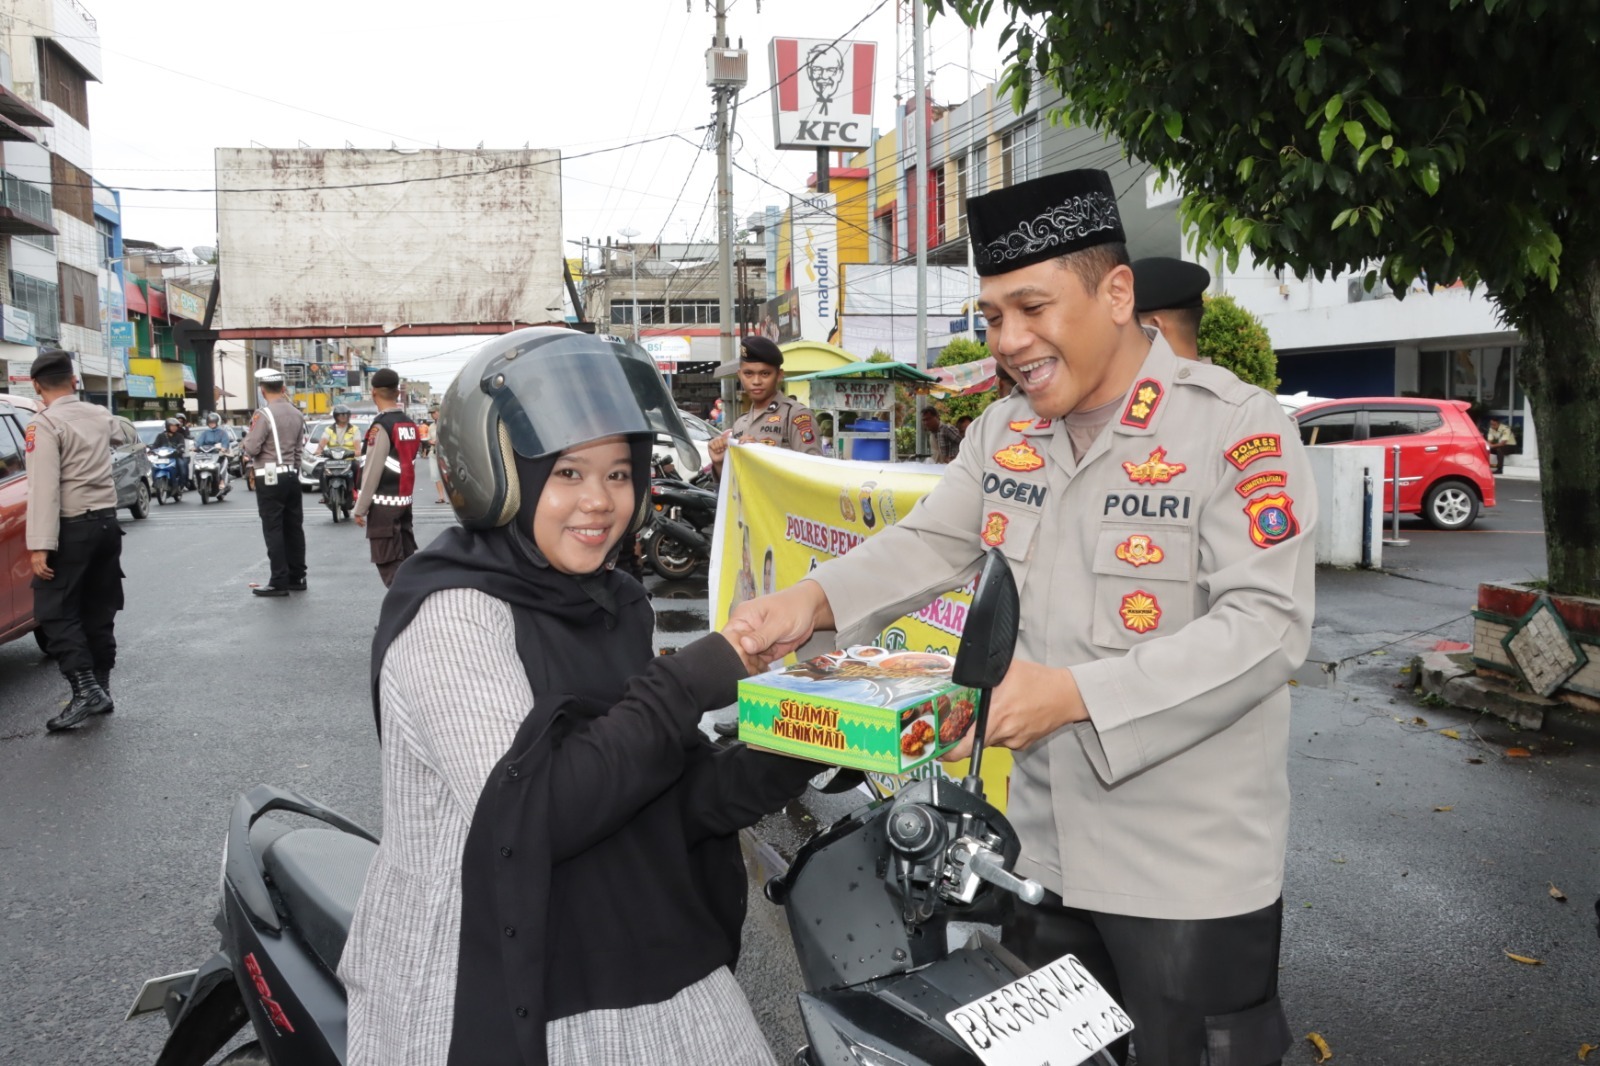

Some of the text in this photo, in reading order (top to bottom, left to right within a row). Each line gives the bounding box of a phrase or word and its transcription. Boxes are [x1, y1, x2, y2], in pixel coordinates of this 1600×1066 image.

[796, 120, 859, 142] KFC
[803, 198, 828, 208] atm
[814, 248, 829, 318] mandiri
[1231, 438, 1276, 460] POLRES
[982, 472, 1048, 507] OGEN
[1103, 493, 1191, 519] POLRI
[786, 515, 829, 550] POLRES
[781, 698, 840, 729] SELAMAT
[773, 717, 846, 751] MENIKMATI
